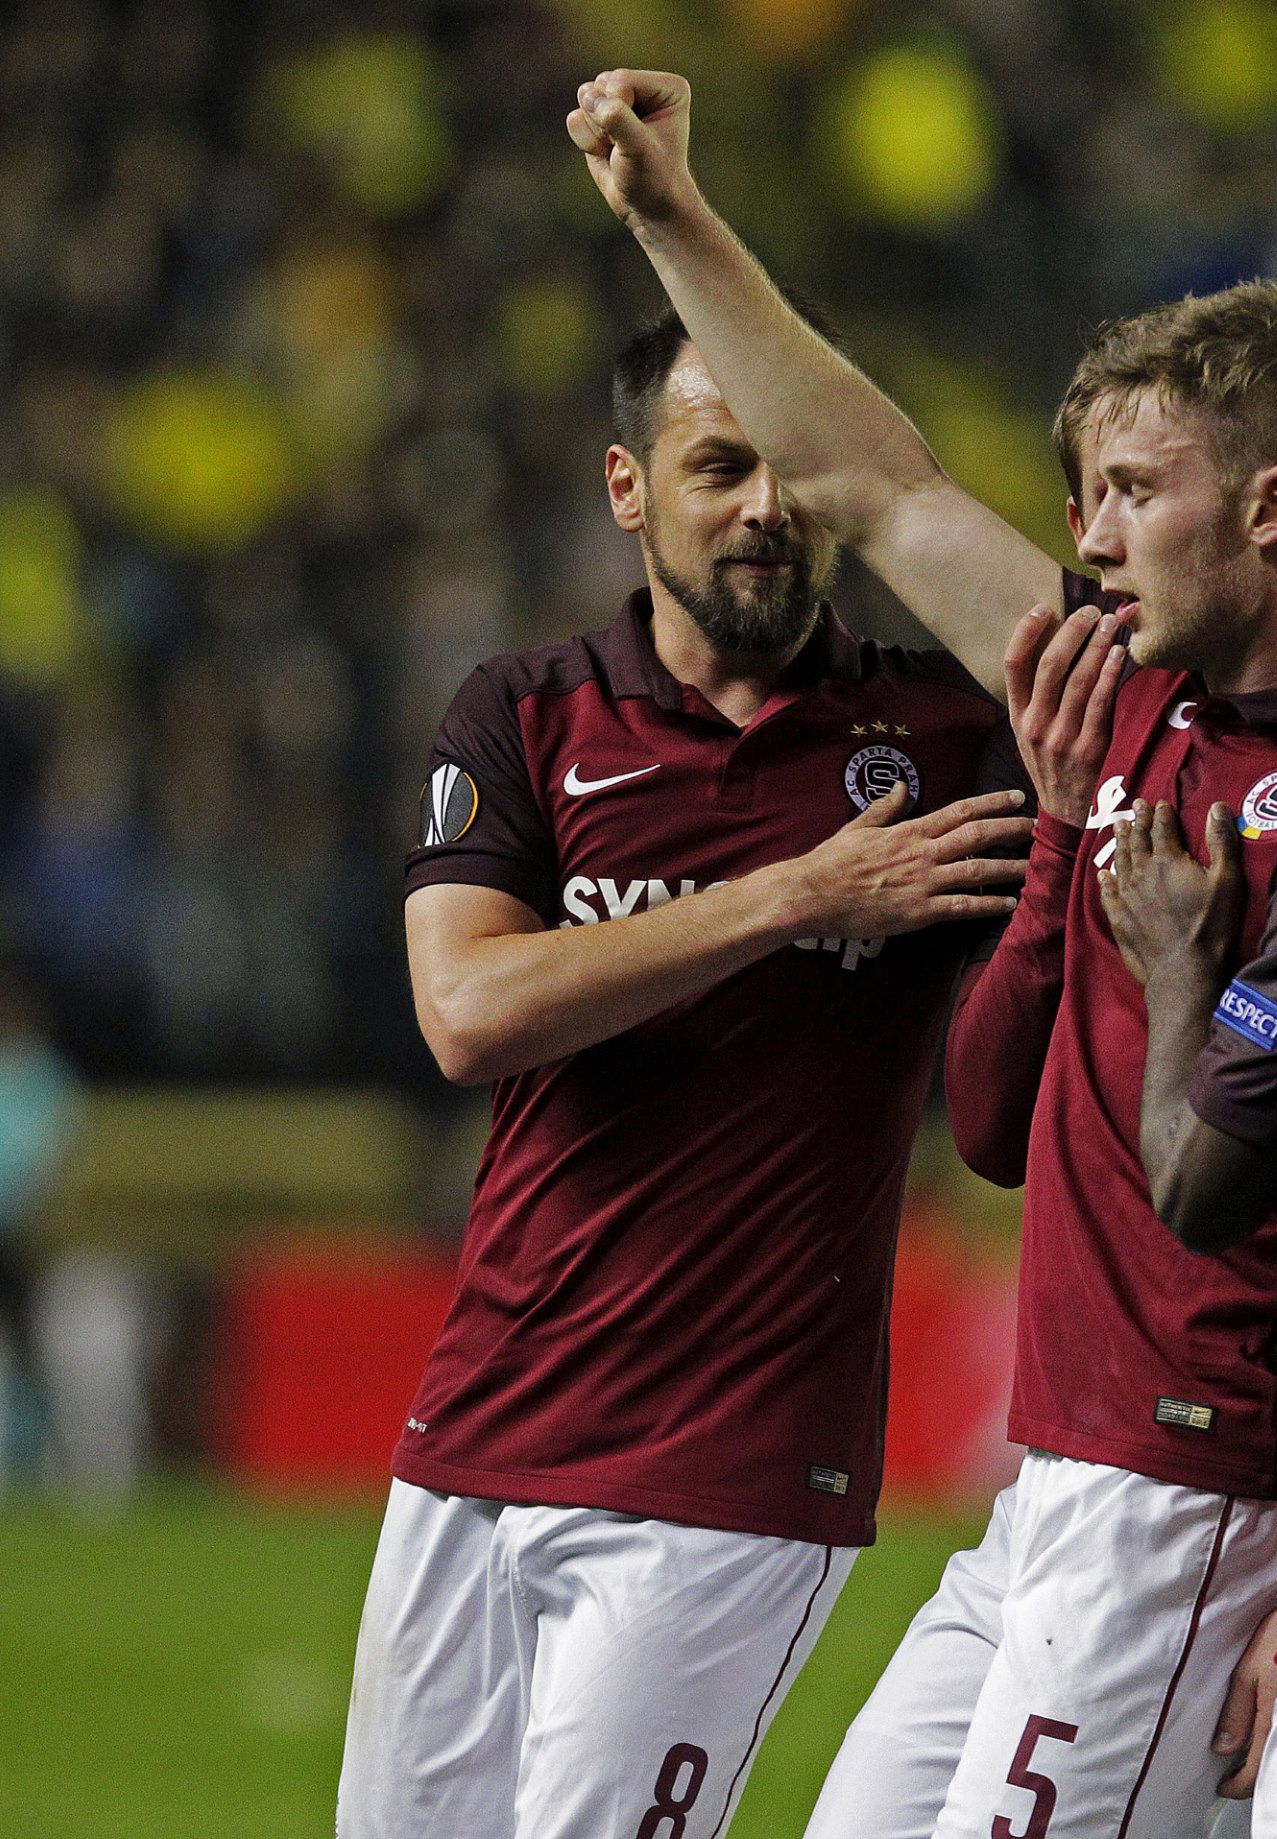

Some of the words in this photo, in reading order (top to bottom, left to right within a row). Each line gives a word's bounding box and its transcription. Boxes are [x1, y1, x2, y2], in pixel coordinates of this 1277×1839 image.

[848, 747, 893, 774] SPARTA
[898, 755, 919, 800] PRAH
[635, 1742, 709, 1839] 8
[991, 1713, 1079, 1839] 5
